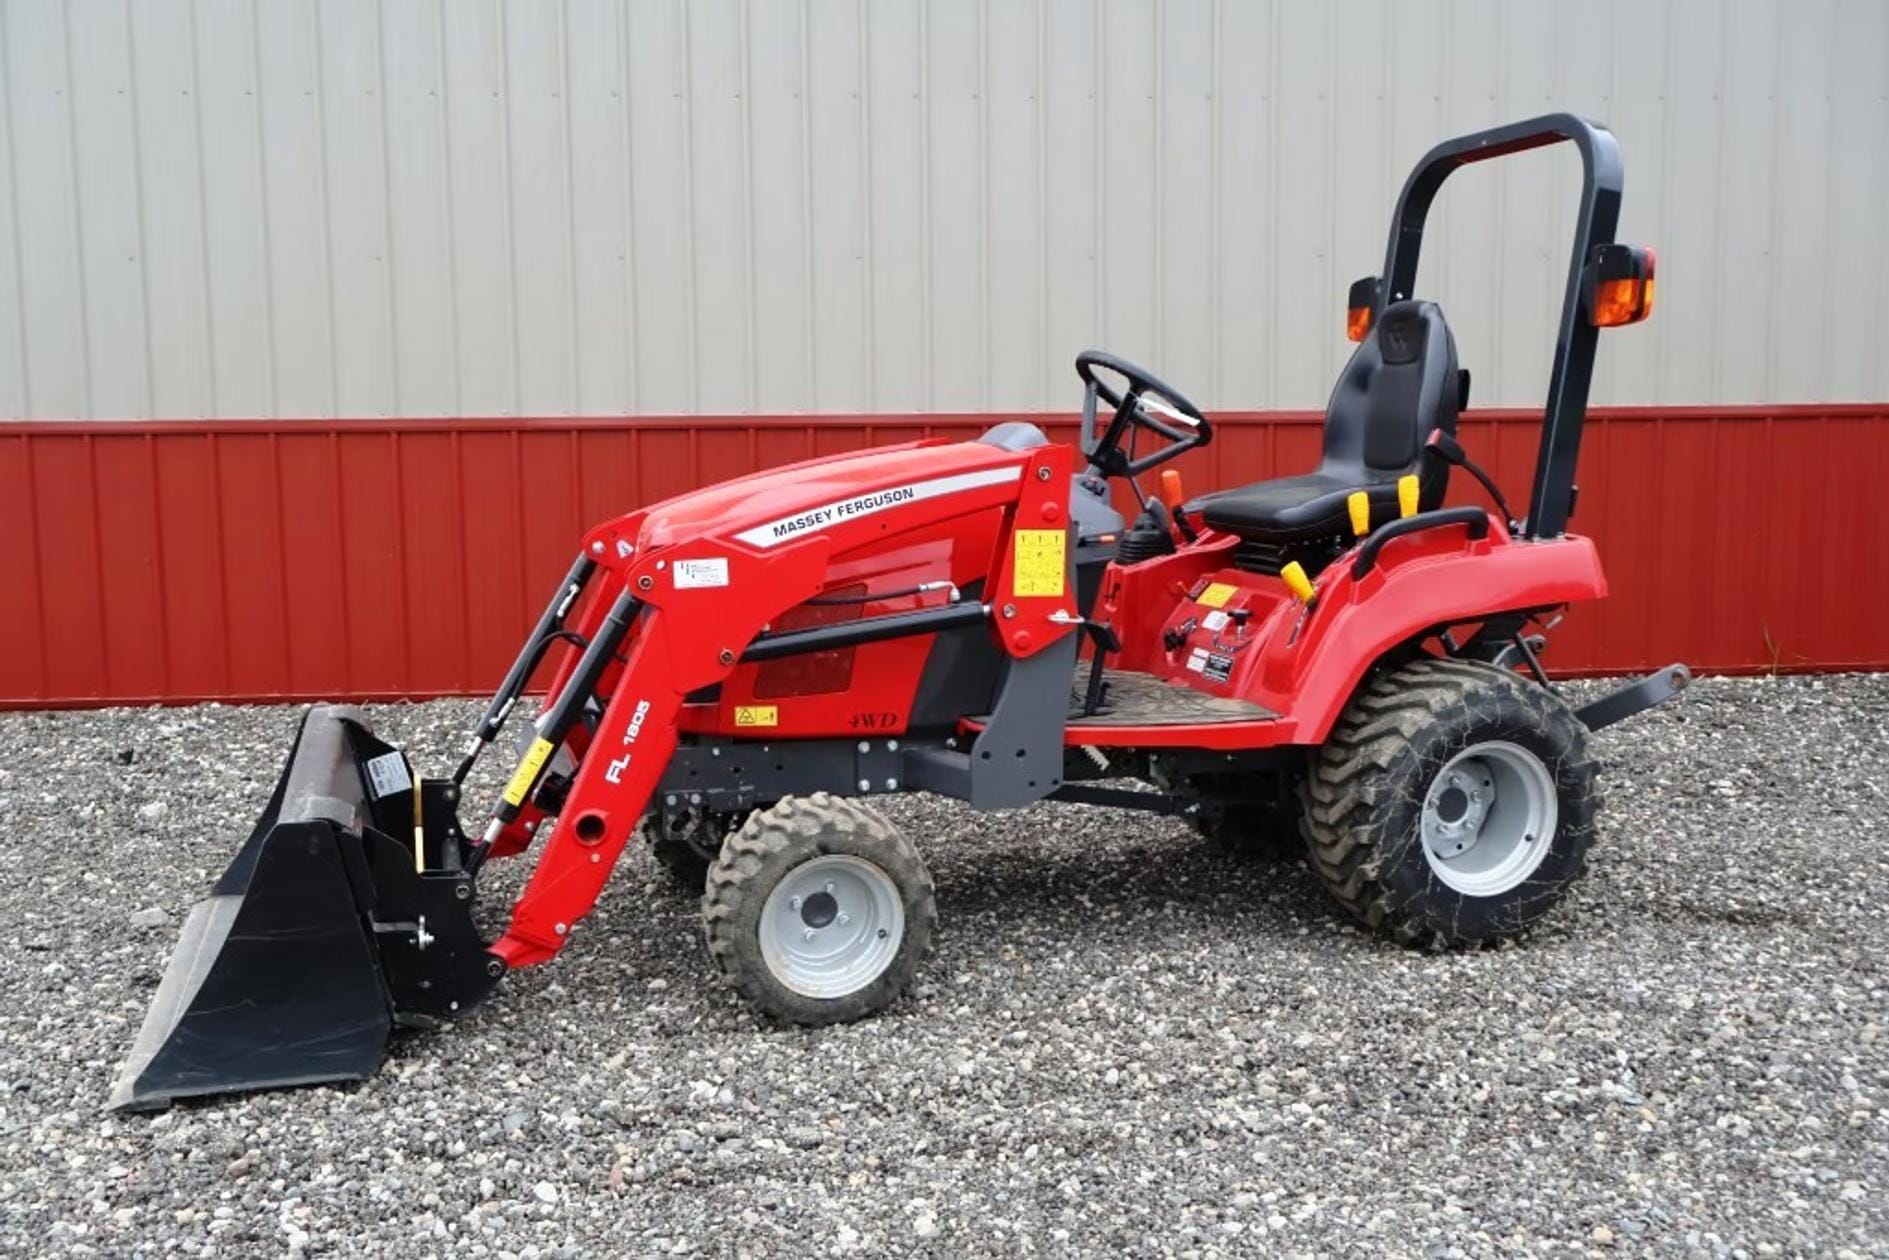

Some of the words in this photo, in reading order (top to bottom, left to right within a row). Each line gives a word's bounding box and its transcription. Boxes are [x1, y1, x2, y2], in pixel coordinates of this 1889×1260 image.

[773, 509, 832, 537] MASSEY
[837, 488, 914, 517] FERGUSON
[605, 753, 631, 784] FL
[623, 699, 651, 746] 1805
[848, 711, 898, 728] 4WD
